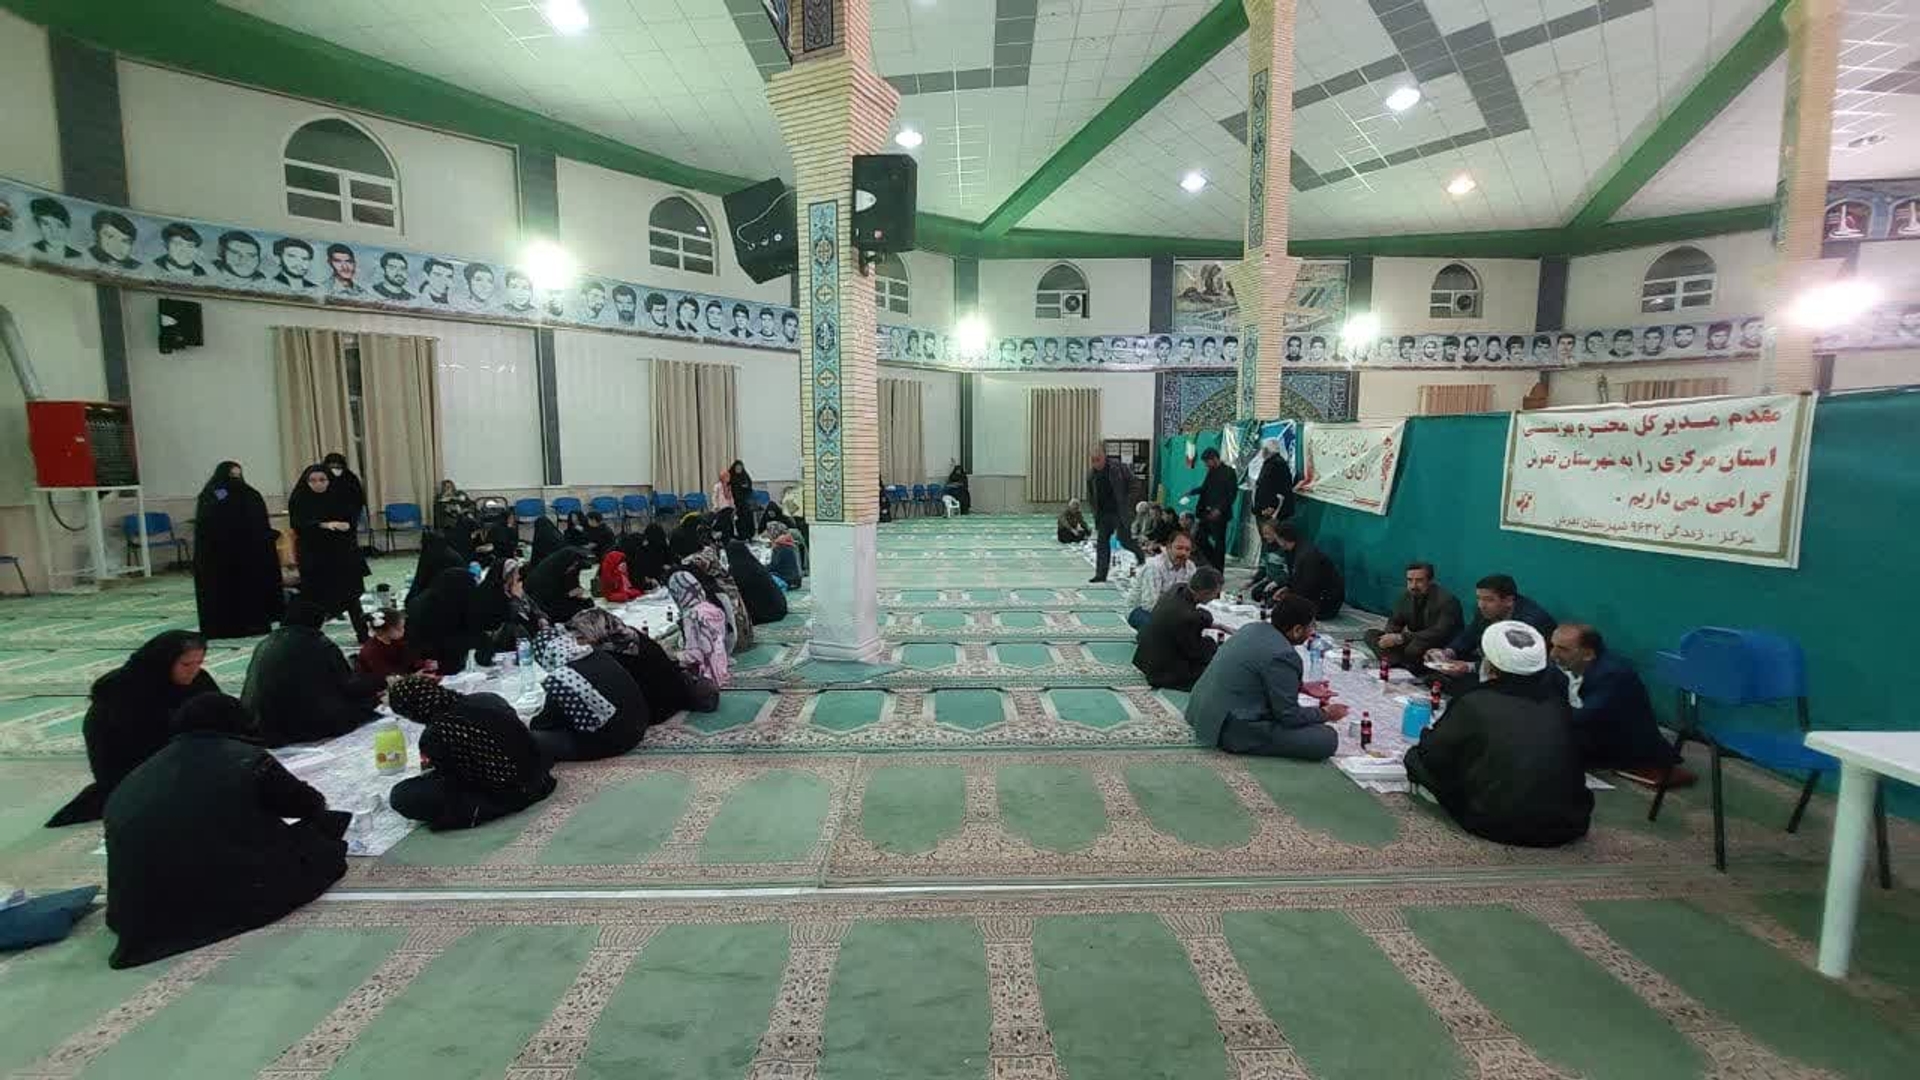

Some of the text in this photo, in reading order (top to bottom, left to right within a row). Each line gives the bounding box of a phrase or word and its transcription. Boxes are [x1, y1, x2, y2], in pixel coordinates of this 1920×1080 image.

[1727, 404, 1781, 431] مقدم
[1523, 421, 1574, 438] بهزیستی
[1577, 420, 1628, 438] محترم
[1526, 446, 1777, 473] استان مرکزی را به شهرستان تفرش
[1673, 496, 1699, 512] می
[1706, 490, 1771, 517] گرامی
[1581, 517, 1628, 533] شهرستان
